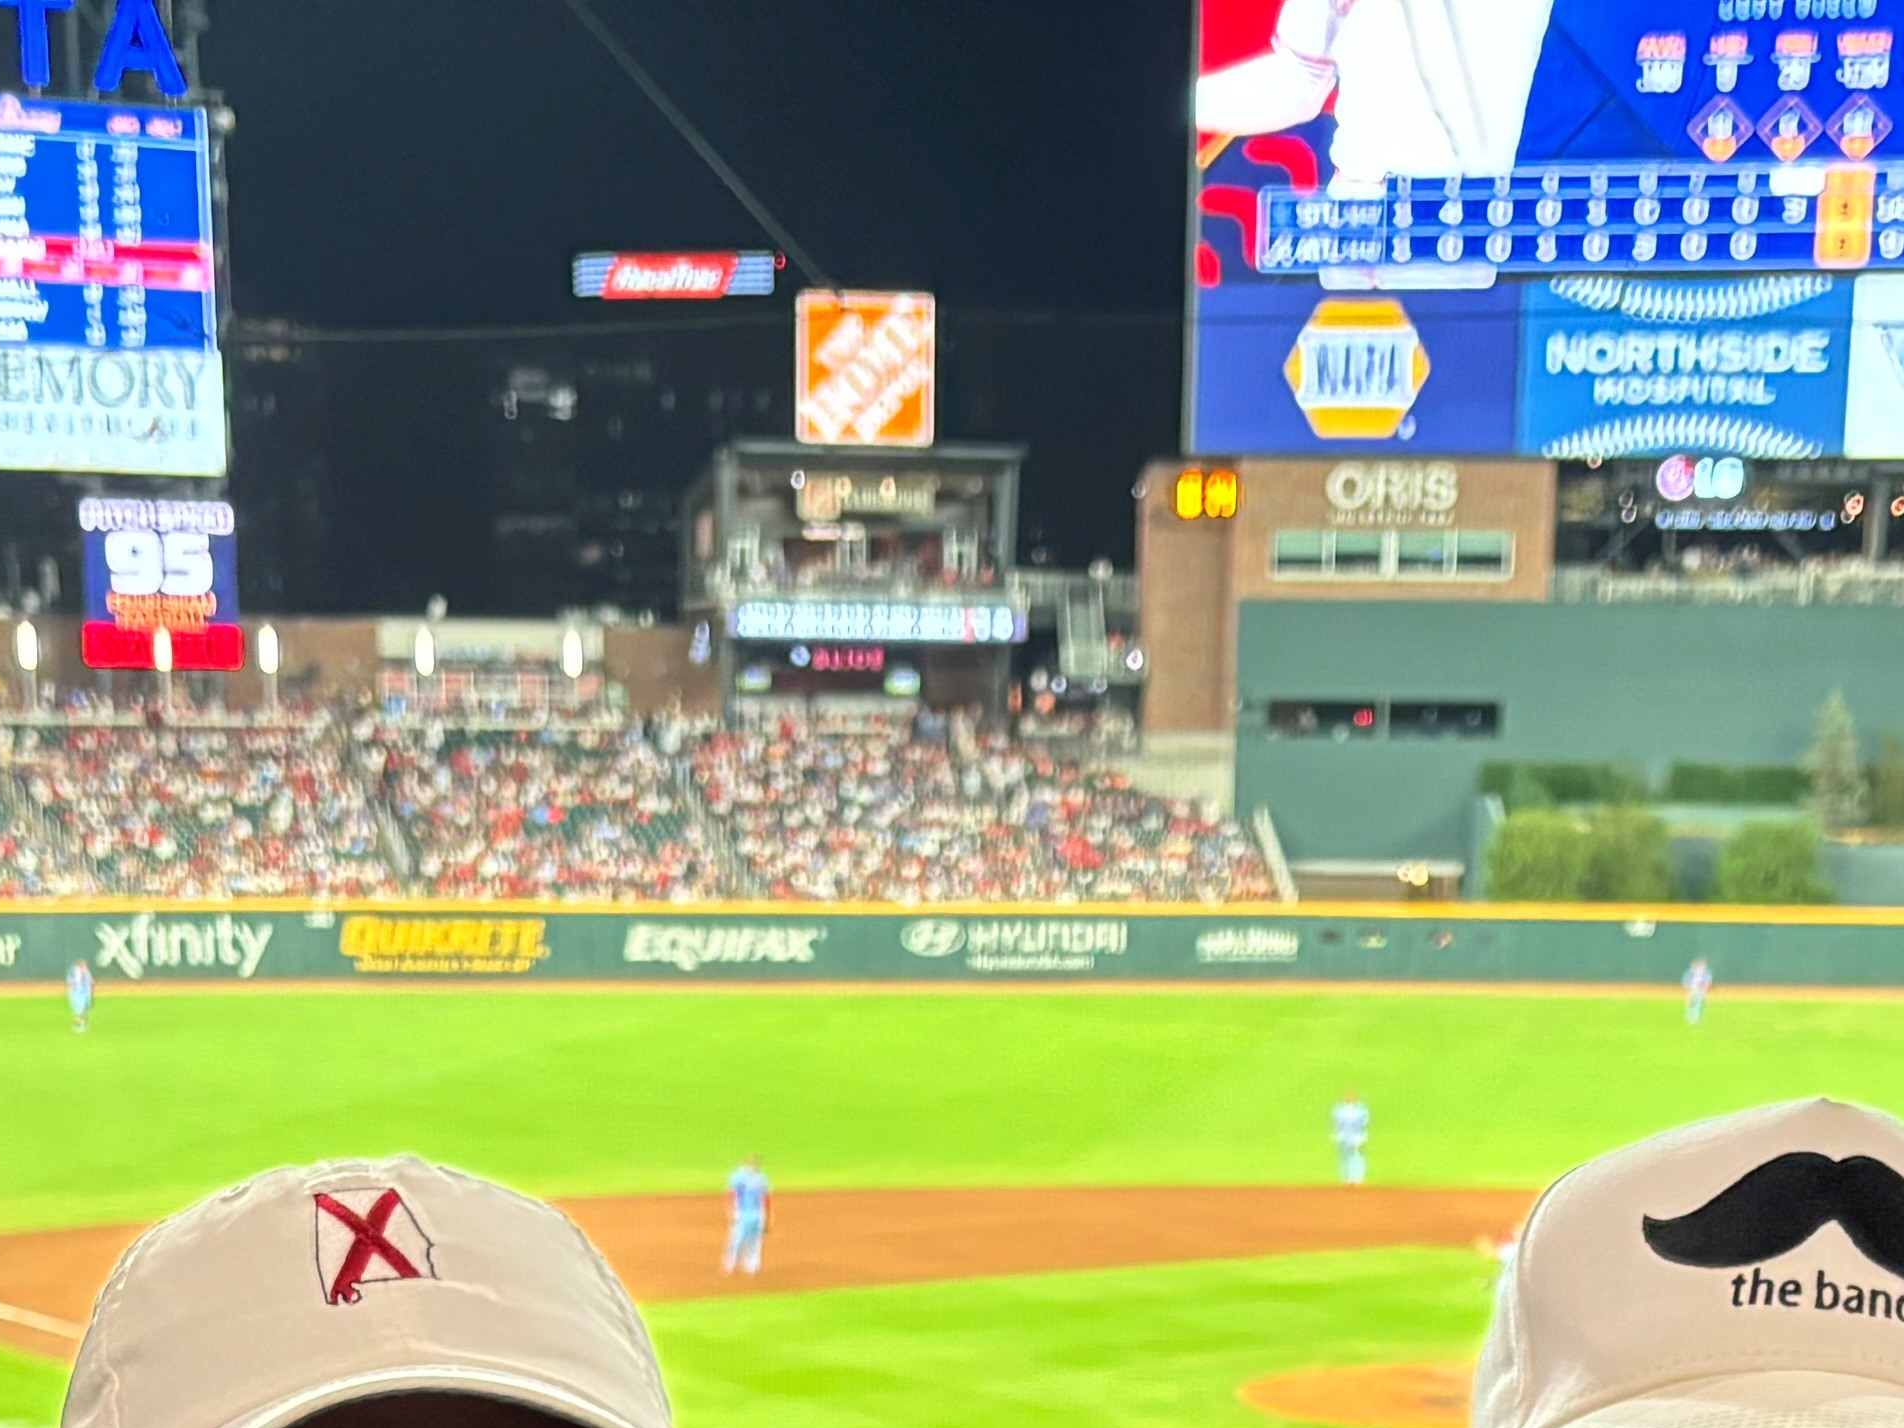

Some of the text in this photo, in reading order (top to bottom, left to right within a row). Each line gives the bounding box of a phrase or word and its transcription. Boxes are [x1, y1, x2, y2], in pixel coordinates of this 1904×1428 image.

[1487, 199, 1513, 227] 0
[1536, 199, 1562, 227] 0
[1683, 197, 1709, 225] 0
[1732, 195, 1759, 225] 0
[1437, 232, 1463, 262] 0
[1486, 232, 1512, 263] 0
[1583, 231, 1610, 262] 0
[1681, 230, 1708, 262] 0
[1730, 229, 1757, 260] 0
[1545, 330, 1830, 375] NORTHSIDE
[1325, 461, 1459, 511] ORIS
[105, 530, 213, 596] 95
[96, 913, 274, 979] xfinity
[624, 923, 818, 972] EQUIFAX
[967, 919, 1128, 955] HYUNDAI
[1731, 1267, 1802, 1310] the
